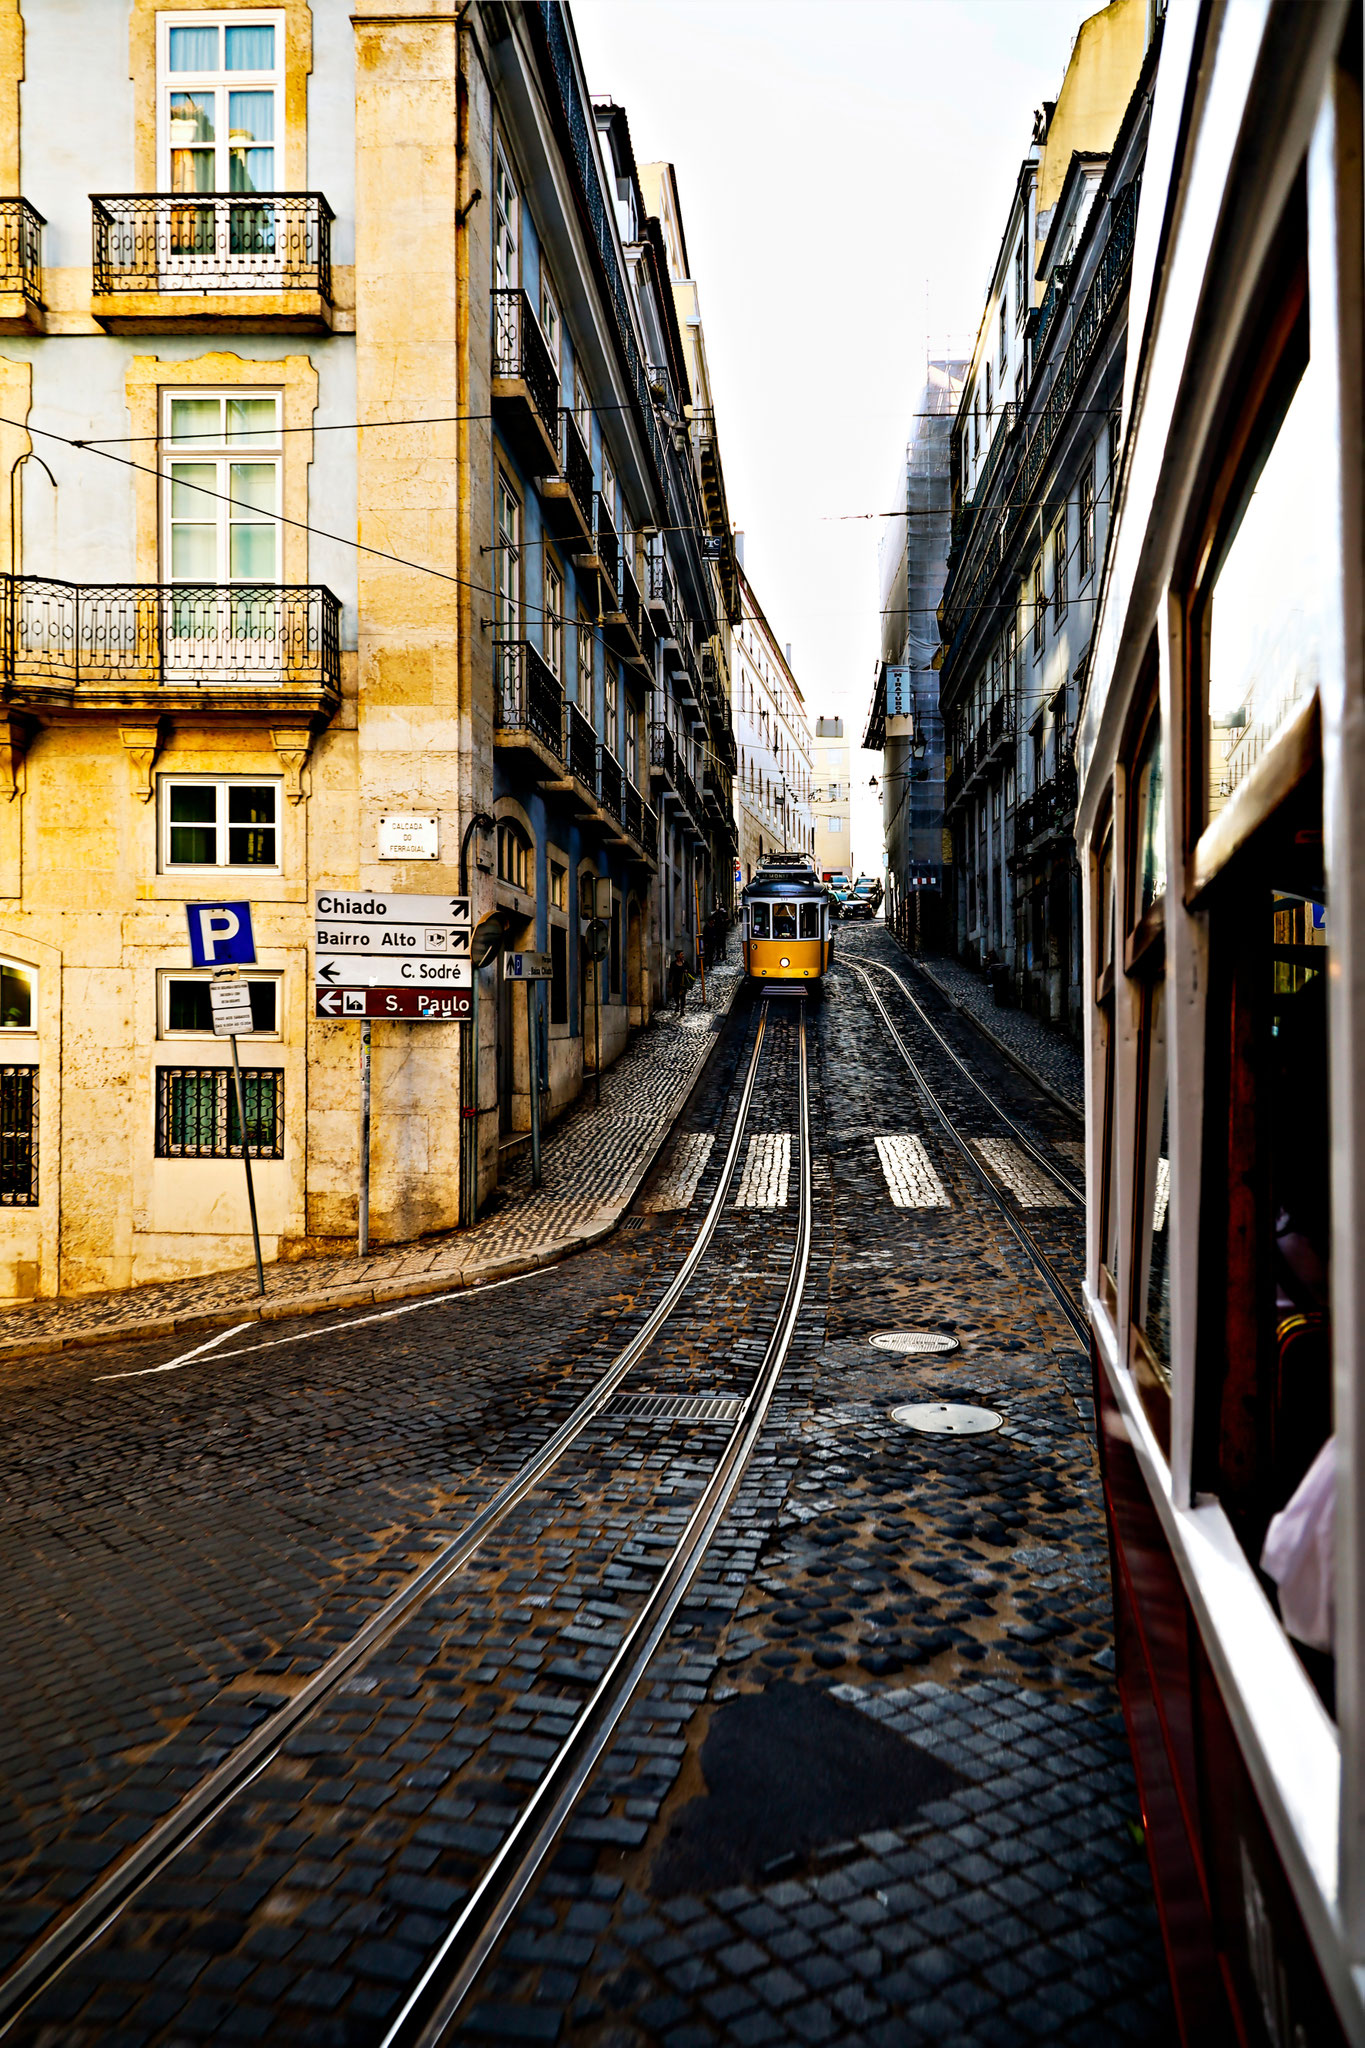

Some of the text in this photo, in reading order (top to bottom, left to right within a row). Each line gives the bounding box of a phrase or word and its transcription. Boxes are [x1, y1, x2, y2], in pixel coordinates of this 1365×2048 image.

[317, 897, 387, 915] Chiado
[198, 908, 240, 961] P
[317, 931, 416, 946] Bairro Alto
[401, 963, 461, 979] C. Sodré
[385, 995, 470, 1012] S. Paulo
